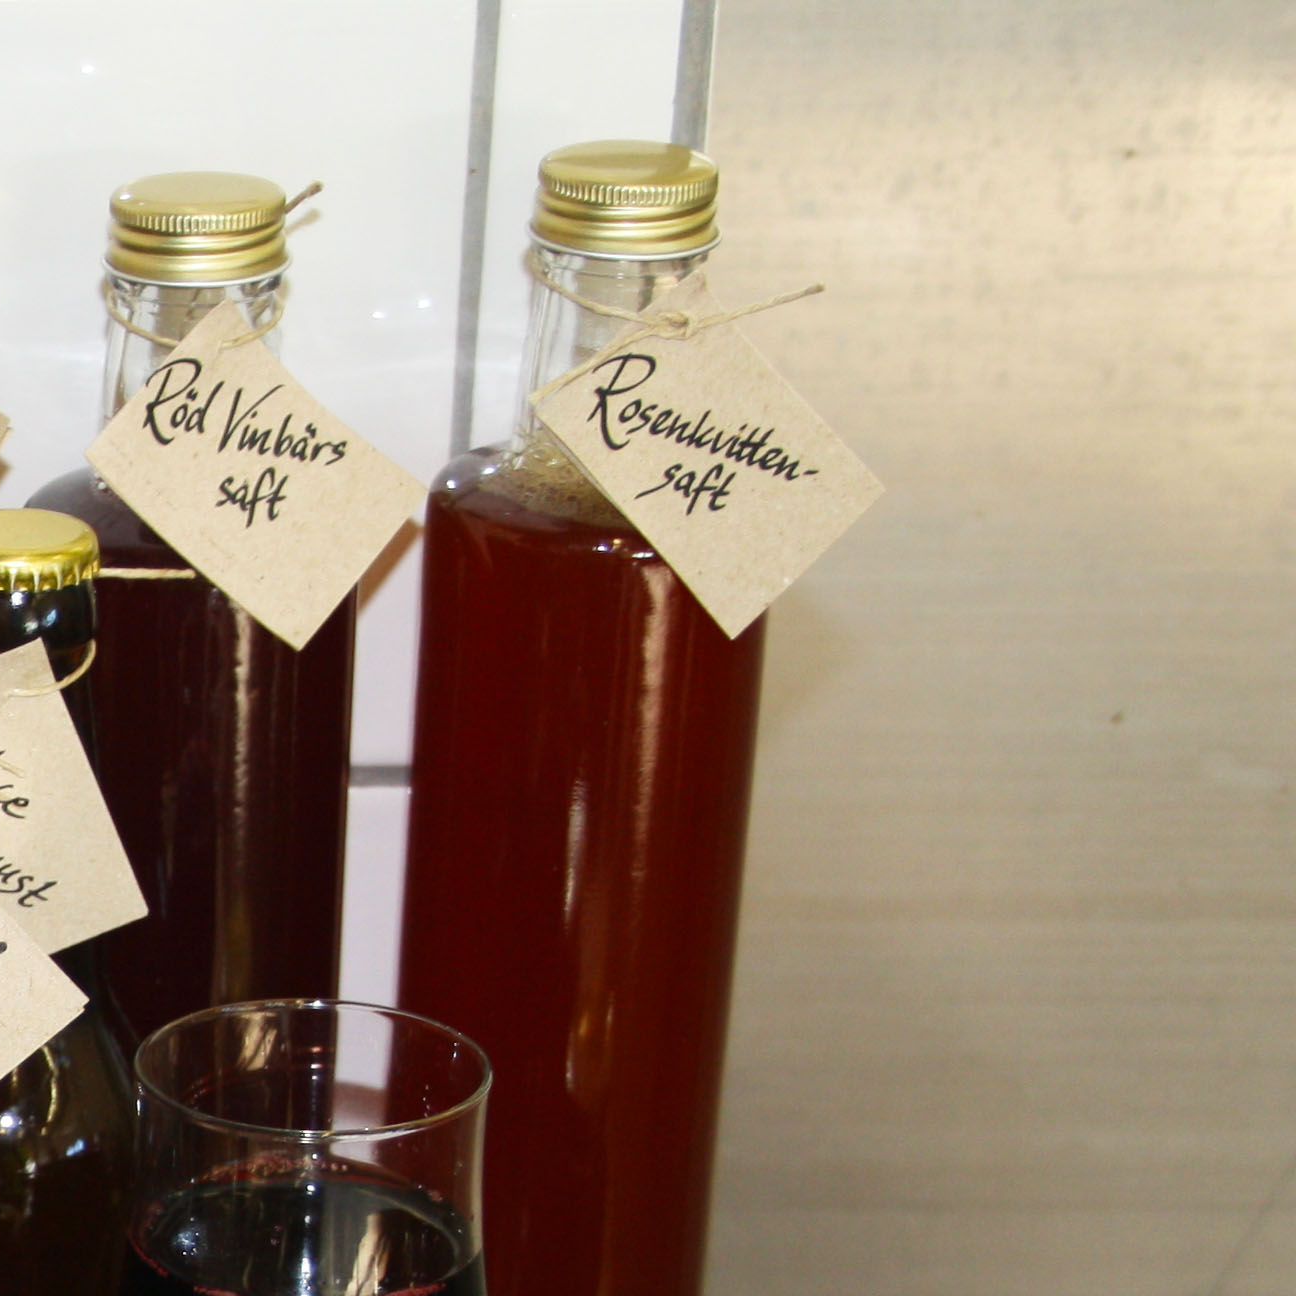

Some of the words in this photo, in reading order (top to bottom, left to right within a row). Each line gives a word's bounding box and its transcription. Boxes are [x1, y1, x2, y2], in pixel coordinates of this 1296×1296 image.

[143, 359, 219, 444] Röd
[217, 385, 348, 468] Vinbärs
[587, 353, 819, 481] Rosenkvitten-
[217, 468, 290, 529] saft
[634, 463, 737, 515] saft
